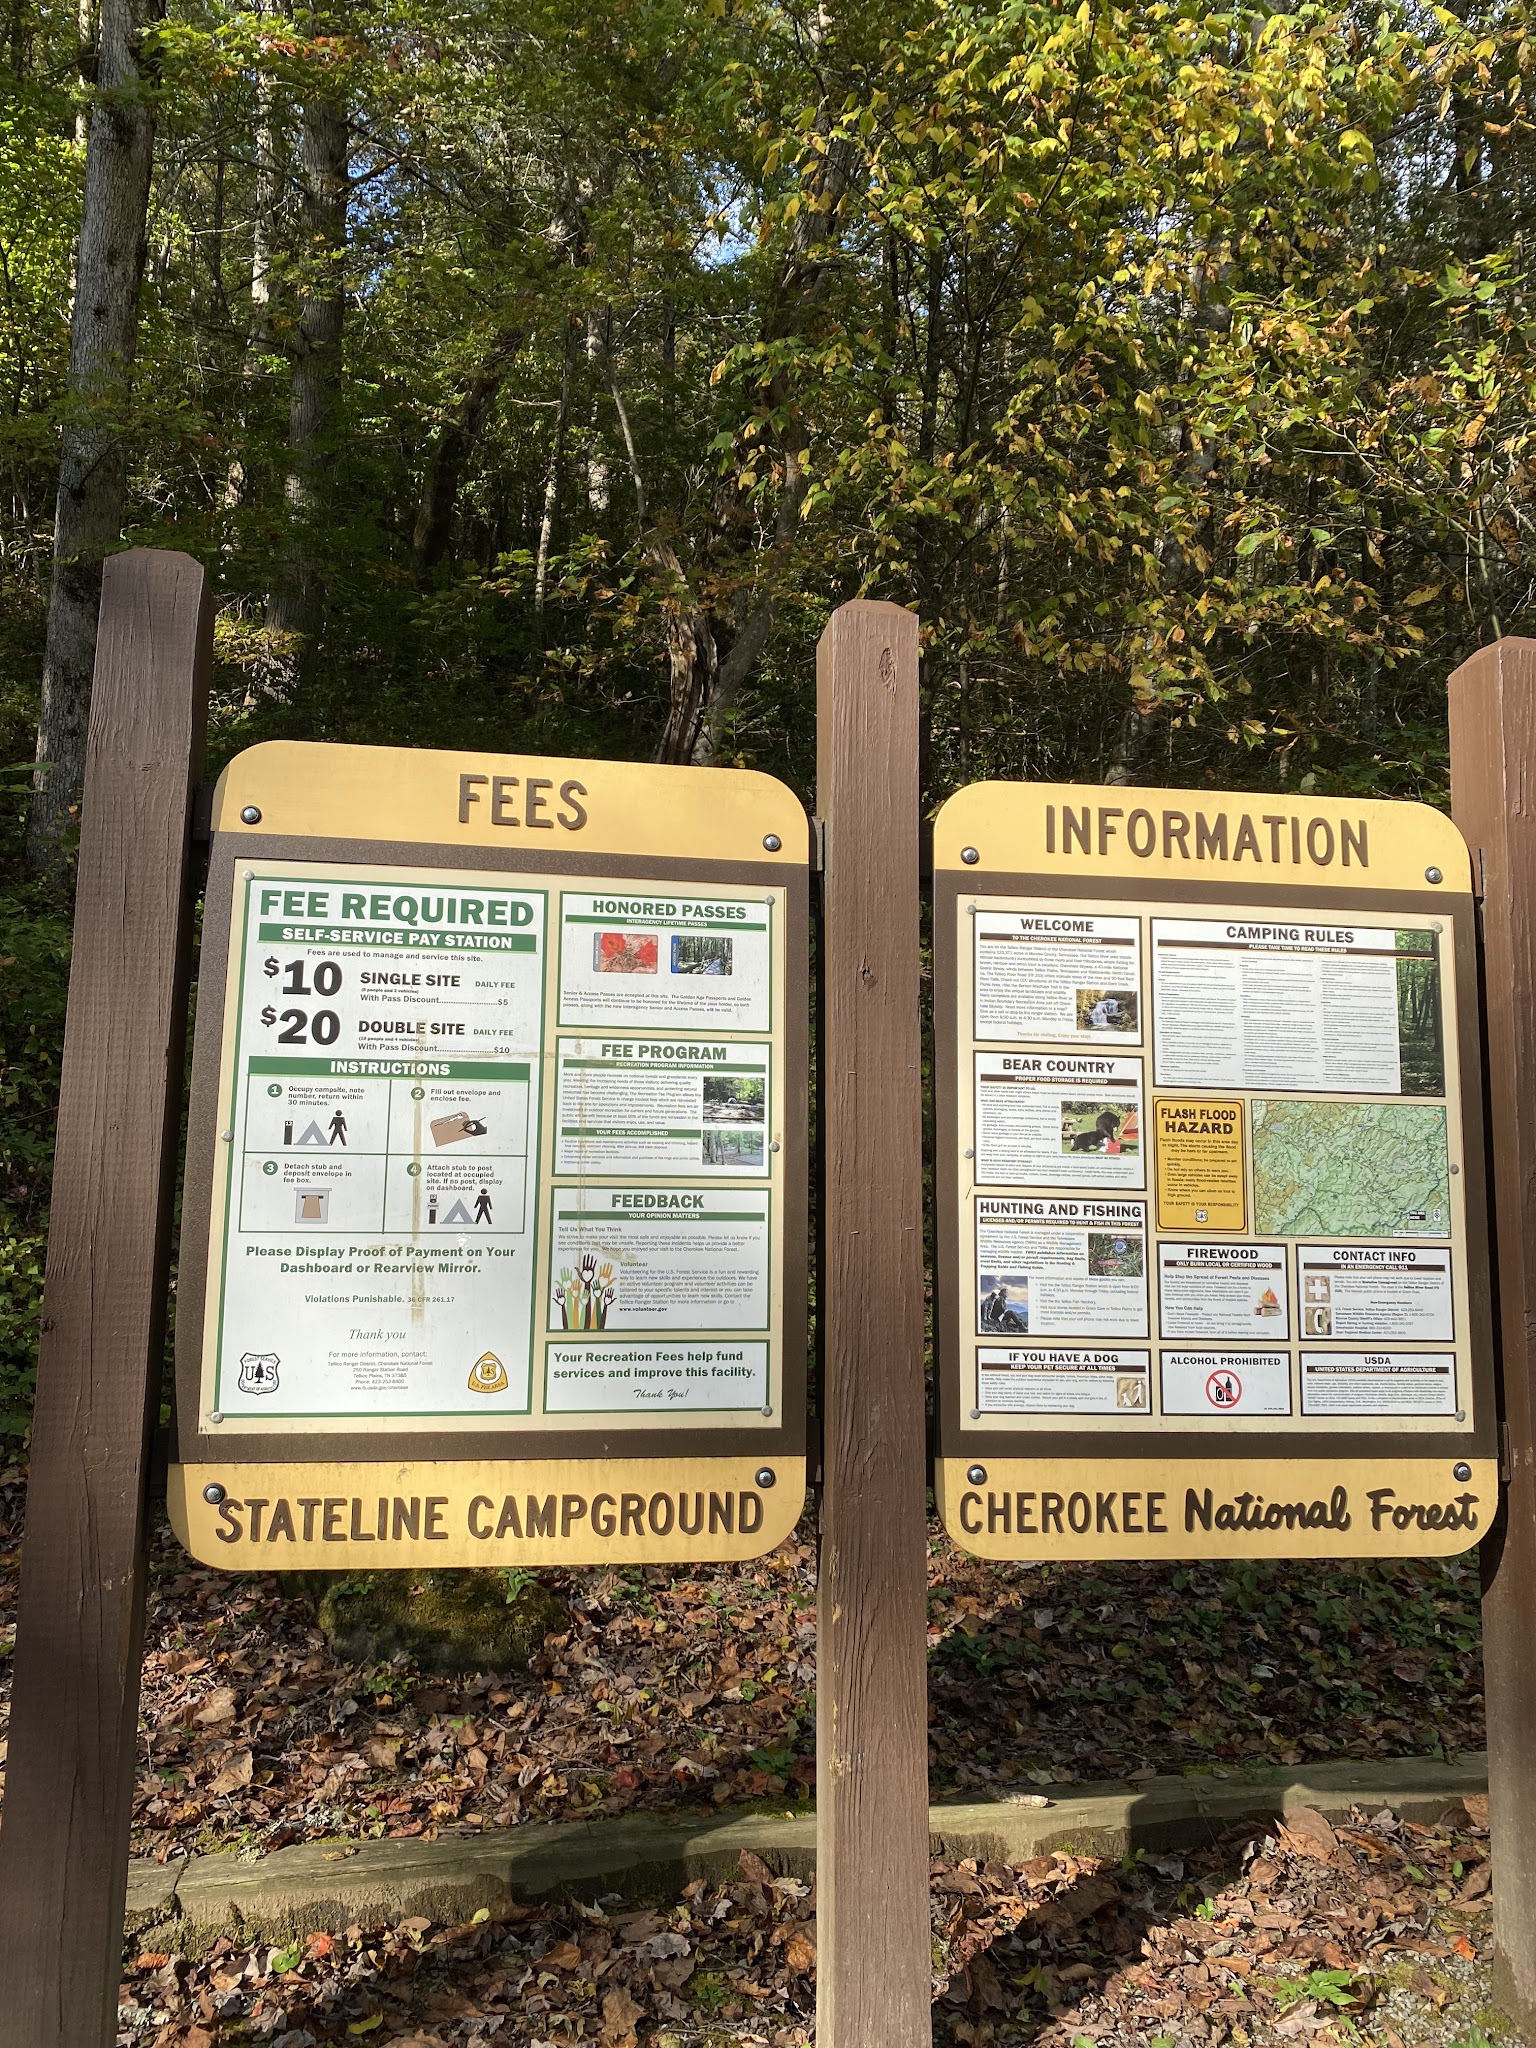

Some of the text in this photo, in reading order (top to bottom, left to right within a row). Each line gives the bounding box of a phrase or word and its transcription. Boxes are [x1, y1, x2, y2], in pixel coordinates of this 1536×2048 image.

[458, 774, 588, 831] FEES
[1046, 805, 1368, 867] INFORMATION
[260, 890, 534, 926] FEE REQUIRED
[593, 900, 746, 919] HONORED PASSES
[1021, 919, 1094, 932] WELCOME
[282, 928, 512, 948] SELF-SERVICE PAY STATION
[1226, 926, 1354, 943] CAMPING RULES
[373, 952, 404, 960] manage
[263, 956, 343, 996] $10
[360, 972, 421, 986] SINGLE
[426, 974, 460, 987] SITE
[260, 1004, 341, 1046] $20
[358, 1020, 426, 1034] DOUBLE
[430, 1023, 465, 1036] SITE
[474, 1028, 496, 1036] DAILY
[602, 1044, 727, 1060] FEE PROGRAM
[330, 1060, 450, 1076] INSTRUCTIONS
[1003, 1059, 1115, 1073] BEAR COUNTRY
[271, 1086, 279, 1094] 1
[1161, 1108, 1236, 1120] FLASH FLOOD
[1165, 1121, 1233, 1134] HAZARD
[267, 1164, 274, 1172] 3
[612, 1194, 704, 1208] FEEDBACK
[980, 1202, 1142, 1217] HUNTING AND FISHING
[246, 1246, 516, 1259] Please Display Proof of Payment on Your
[1187, 1248, 1258, 1259] FIREWOOD
[1333, 1251, 1416, 1261] CONTACT INFO
[280, 1263, 481, 1273] Dashboard or Rearview Mirror.
[305, 1295, 350, 1303] Violations
[353, 1295, 404, 1303] Punishable.
[349, 1329, 407, 1342] Thank you
[554, 1351, 743, 1362] Your Recreation Fees help fund
[1023, 1353, 1046, 1361] YOU
[1050, 1353, 1080, 1362] HAVE
[1083, 1354, 1091, 1362] A
[1094, 1354, 1119, 1363] DOG
[1221, 1357, 1280, 1365] PROHIBITED
[554, 1367, 755, 1379] services and improve this facility.
[633, 1389, 689, 1399] Thank You!
[959, 1485, 1480, 1534] CHEROKEE National Forest
[215, 1491, 764, 1544] STATELINE CAMPGROUND
